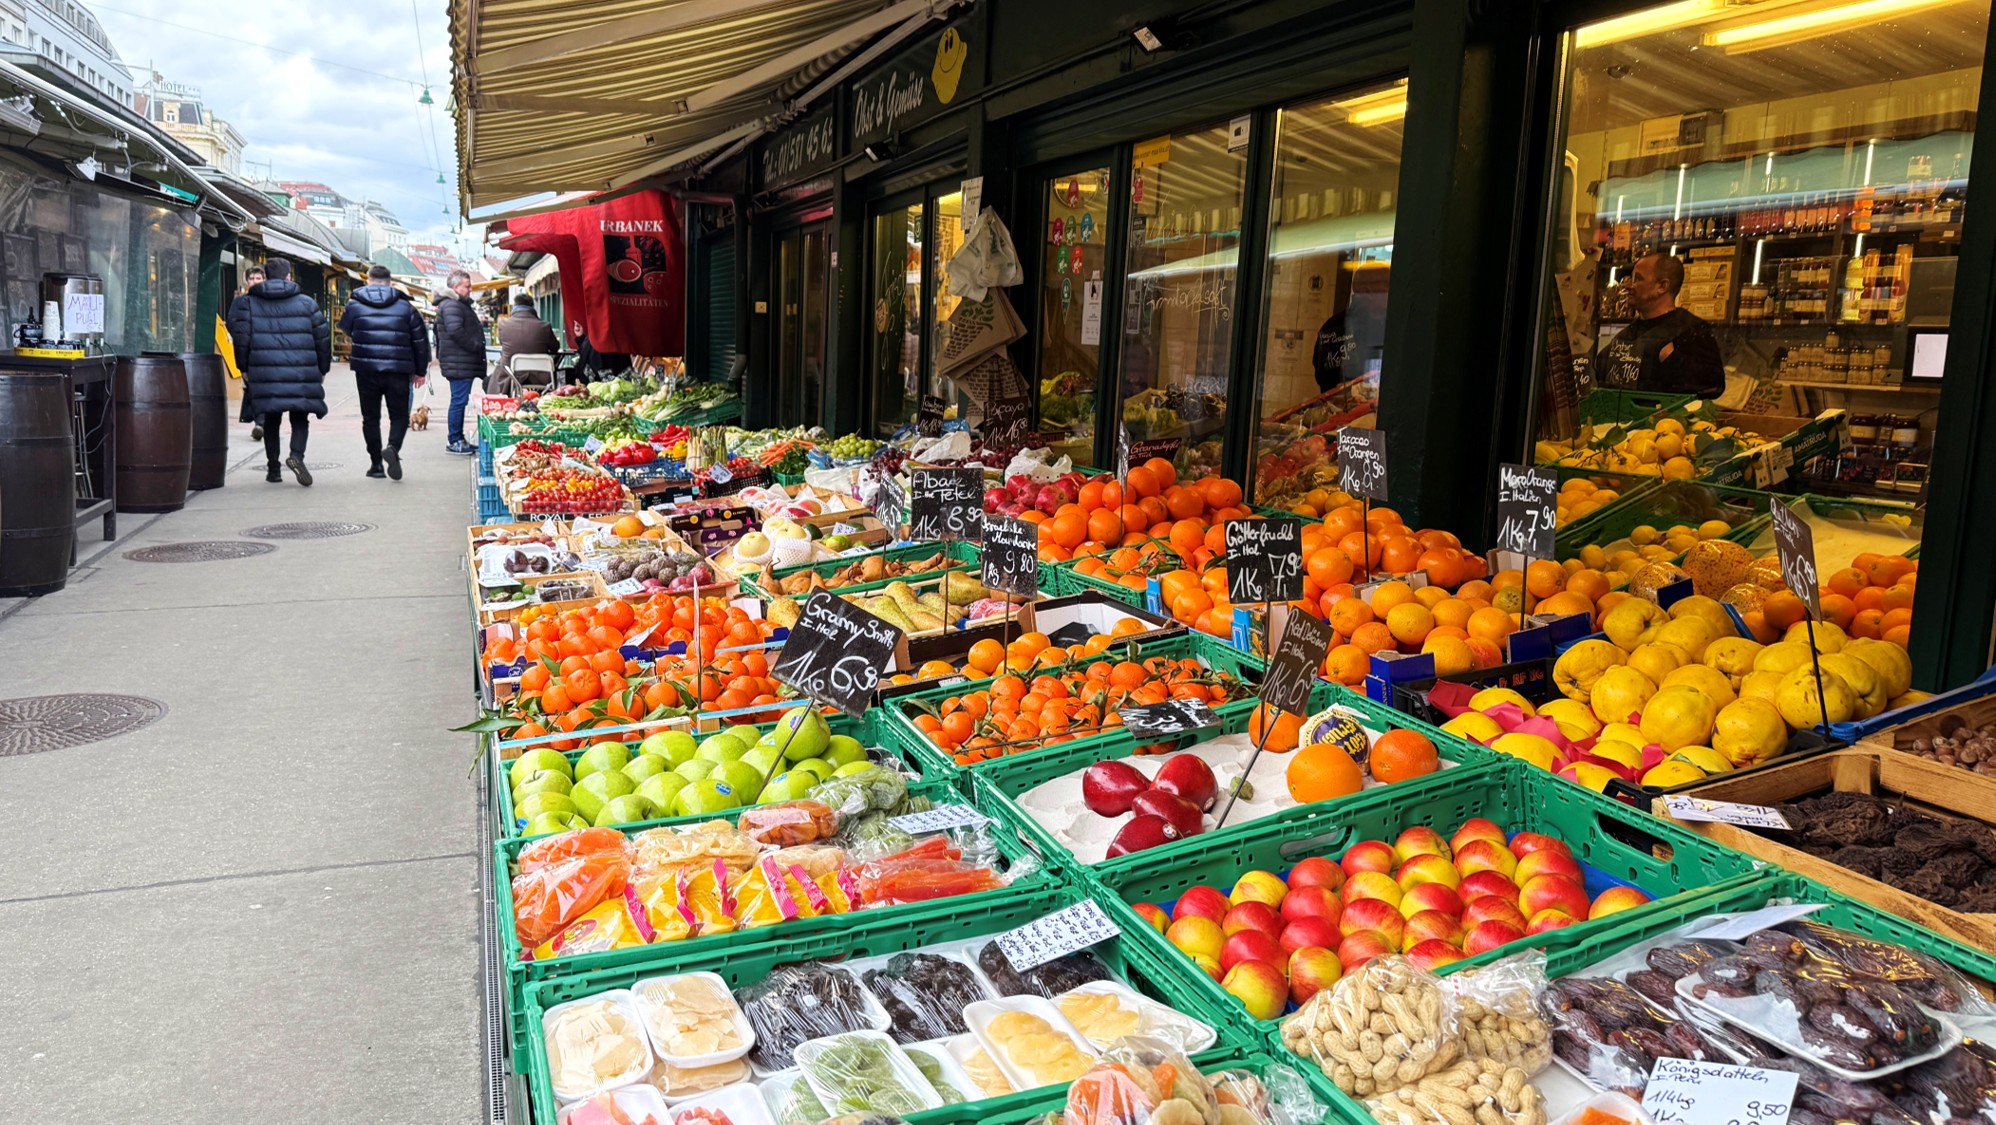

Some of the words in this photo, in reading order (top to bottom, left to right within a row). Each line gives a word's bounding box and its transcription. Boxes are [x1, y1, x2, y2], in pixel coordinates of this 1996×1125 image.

[160, 81, 187, 93] HOTEL
[854, 88, 875, 139] Obst
[876, 81, 884, 127] &
[886, 70, 924, 135] Gemüse
[806, 123, 820, 163] 45
[600, 219, 664, 233] URBANEK
[530, 513, 566, 522] ROYAL
[947, 505, 984, 537] 8,90
[1525, 505, 1556, 551] 7,90
[1003, 550, 1034, 584] 9,80
[1230, 567, 1263, 600] 1Kg
[1267, 552, 1303, 598] 7,90
[806, 592, 865, 649] Granny
[864, 620, 895, 650] Smith
[1285, 608, 1306, 639] Red
[1657, 1059, 1769, 1085] Königsdatteln
[1650, 1107, 1684, 1125] 1K
[1746, 1099, 1788, 1120] 9,50
